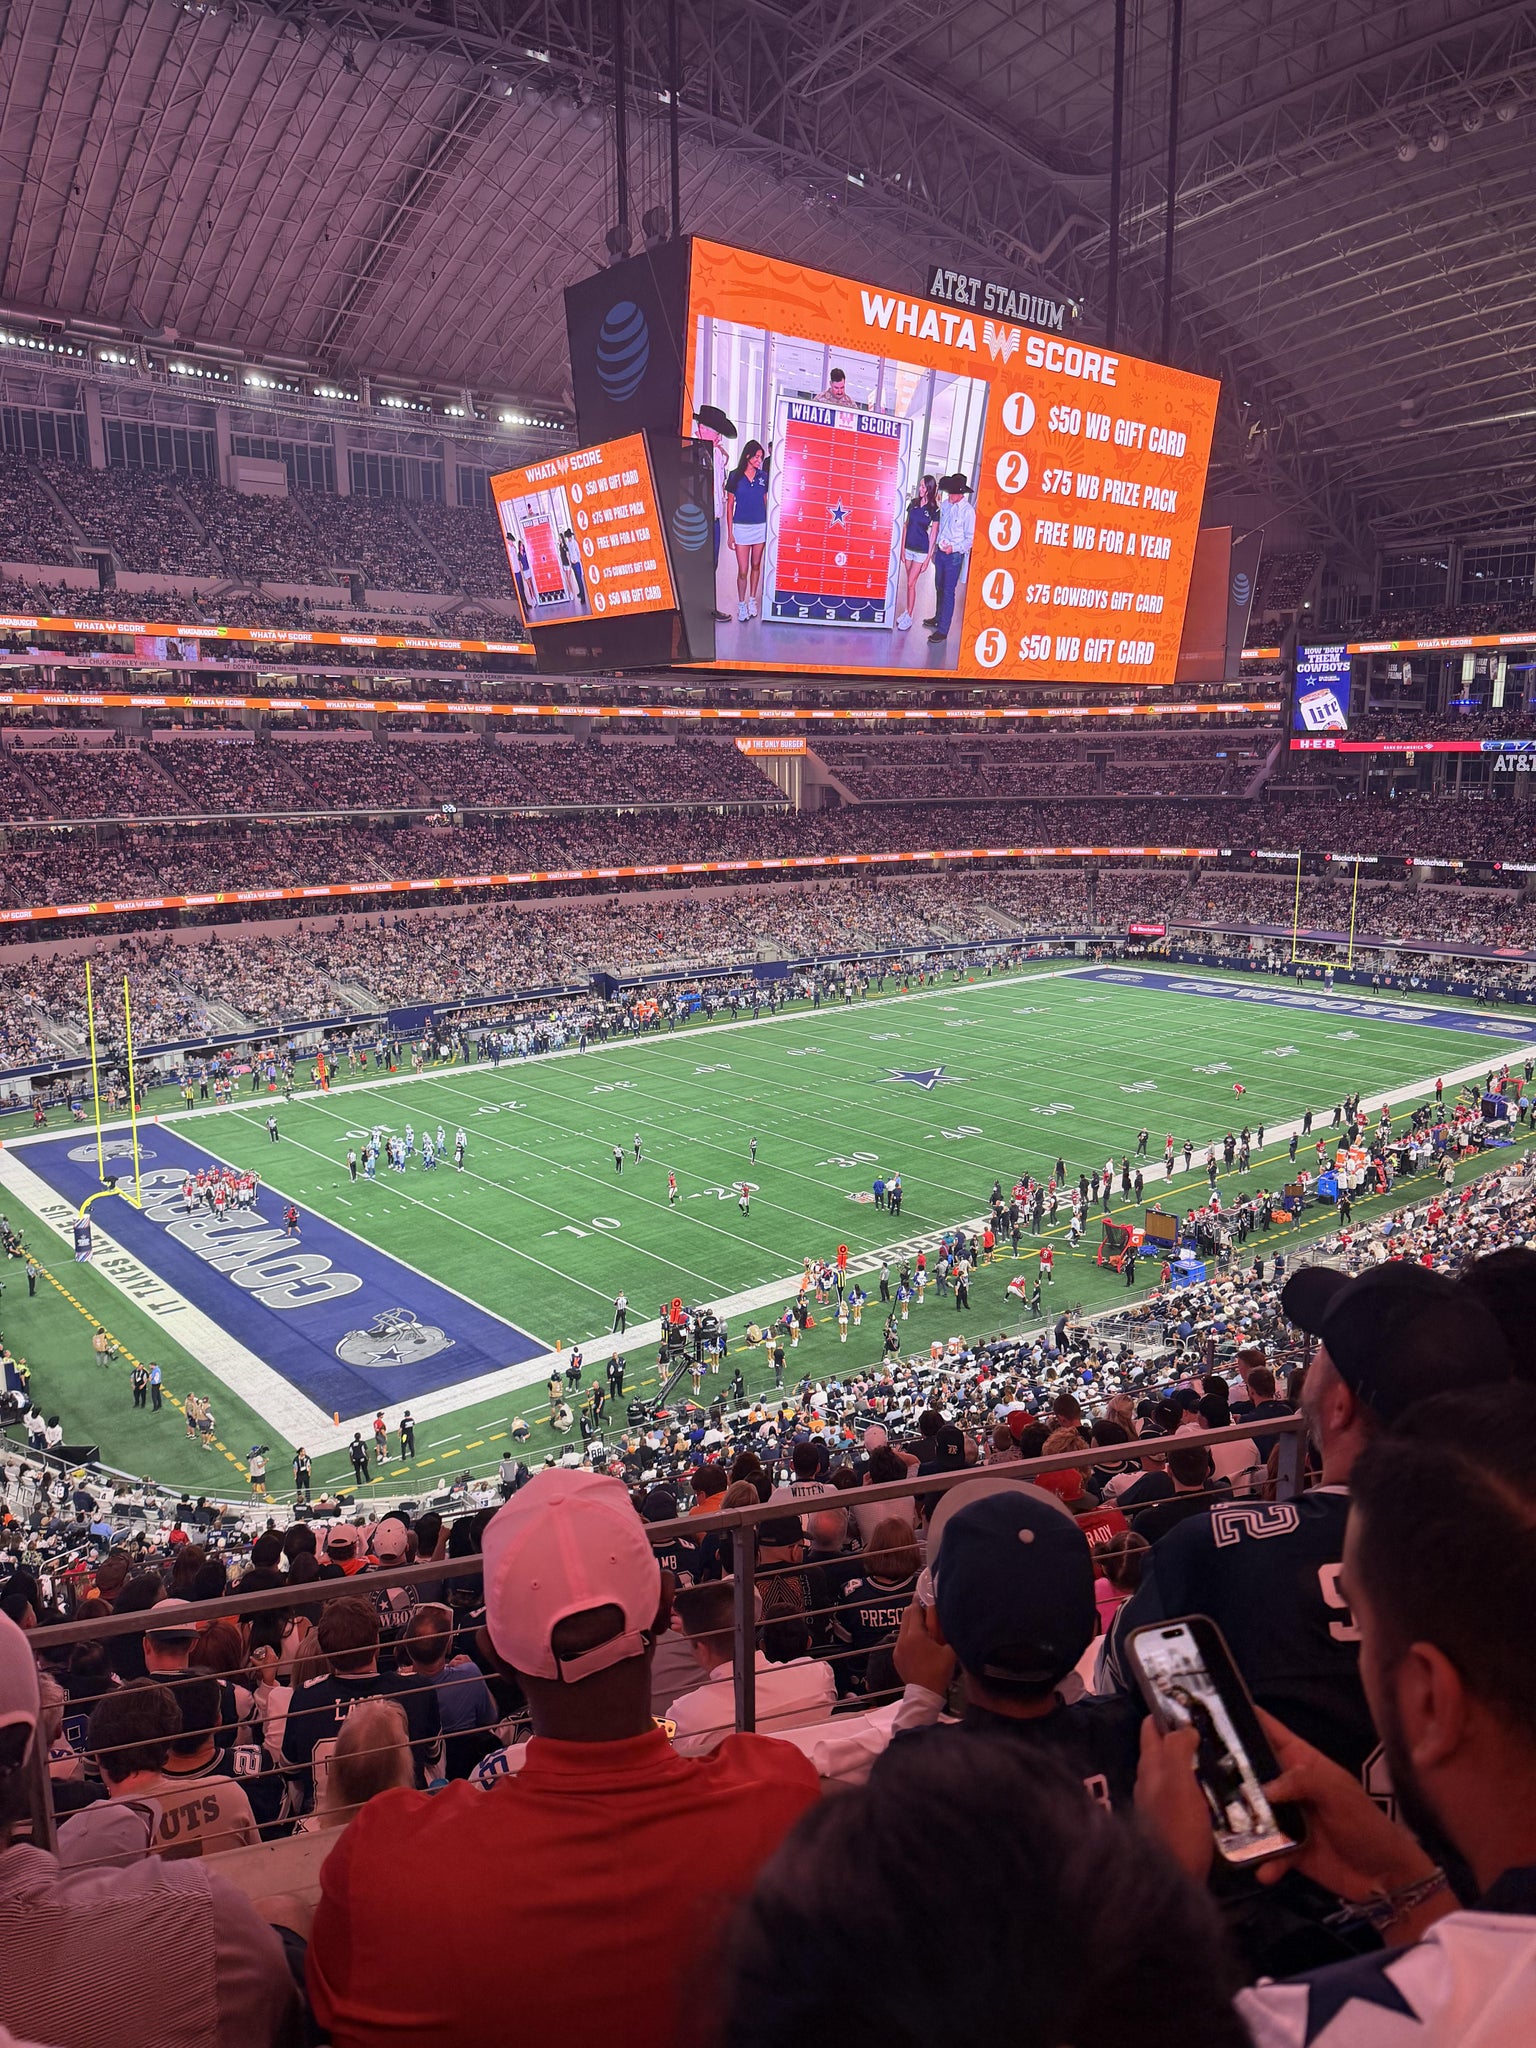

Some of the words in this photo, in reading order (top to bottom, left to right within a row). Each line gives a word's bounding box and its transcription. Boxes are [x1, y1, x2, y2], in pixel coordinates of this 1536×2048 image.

[930, 268, 981, 306] AT&T
[984, 283, 1066, 331] STADIUM
[860, 290, 977, 352] WHATA
[1026, 336, 1120, 387] SCORE
[792, 402, 831, 425] WHATA
[861, 416, 898, 437] SCORE
[1048, 405, 1081, 436] $50
[1085, 411, 1111, 442] WB
[1114, 419, 1147, 449] GIFT
[1148, 427, 1187, 458] CARD
[525, 462, 558, 483] WHATA
[570, 449, 602, 471] SCORE
[608, 474, 621, 489] GIFT
[622, 469, 639, 486] CARD
[1042, 469, 1074, 496] $75
[1076, 473, 1100, 501] WB
[1102, 478, 1141, 508] PRIZE
[1143, 486, 1178, 514] PACK
[592, 511, 603, 525] $75
[613, 504, 629, 520] PRIZE
[630, 501, 645, 516] PACK
[596, 536, 610, 550] FREE
[620, 531, 630, 545] FOR
[636, 527, 650, 542] YEAR
[1035, 520, 1070, 548] FREE
[1073, 525, 1096, 551] WB
[1098, 529, 1124, 554] FOR
[1126, 533, 1136, 556] A
[1140, 535, 1172, 560] YEAR
[608, 591, 620, 606] $50
[1026, 584, 1051, 605] $75
[1053, 585, 1108, 610] COWBOYS
[1111, 591, 1134, 611] GIFT
[1135, 594, 1164, 614] CARD
[776, 605, 782, 615] 1
[799, 607, 809, 618] 2
[826, 609, 836, 620] 3
[850, 611, 860, 621] 4
[874, 612, 884, 622] 5
[74, 622, 105, 631] WHATA
[118, 624, 146, 632] SCORE
[250, 631, 276, 639] WHATA
[1018, 635, 1051, 661] $50
[1055, 636, 1081, 662] WB
[1084, 638, 1116, 664] GIFT
[1117, 640, 1156, 665] CARD
[1308, 654, 1340, 663] THEM
[1297, 662, 1350, 673] COWBOYS
[1309, 700, 1338, 724] Lite
[753, 740, 763, 748] THE
[765, 740, 779, 748] ONLY
[781, 740, 804, 748] BURGER
[1413, 858, 1463, 867] Blockchain.com
[1502, 863, 1536, 872] Blockchai
[11, 911, 33, 919] SCORE
[1030, 1101, 1075, 1117] 50
[940, 1124, 984, 1142] 40
[827, 1150, 880, 1169] 30
[703, 1181, 760, 1201] 20
[560, 1216, 622, 1240] 10
[1131, 1235, 1140, 1246] G
[100, 1257, 165, 1299] TAKES
[573, 1356, 581, 1368] K
[790, 1484, 826, 1498] WITTEN
[1085, 1524, 1113, 1550] RADY
[859, 1606, 906, 1628] PRESC
[152, 1794, 221, 1846] UTS
